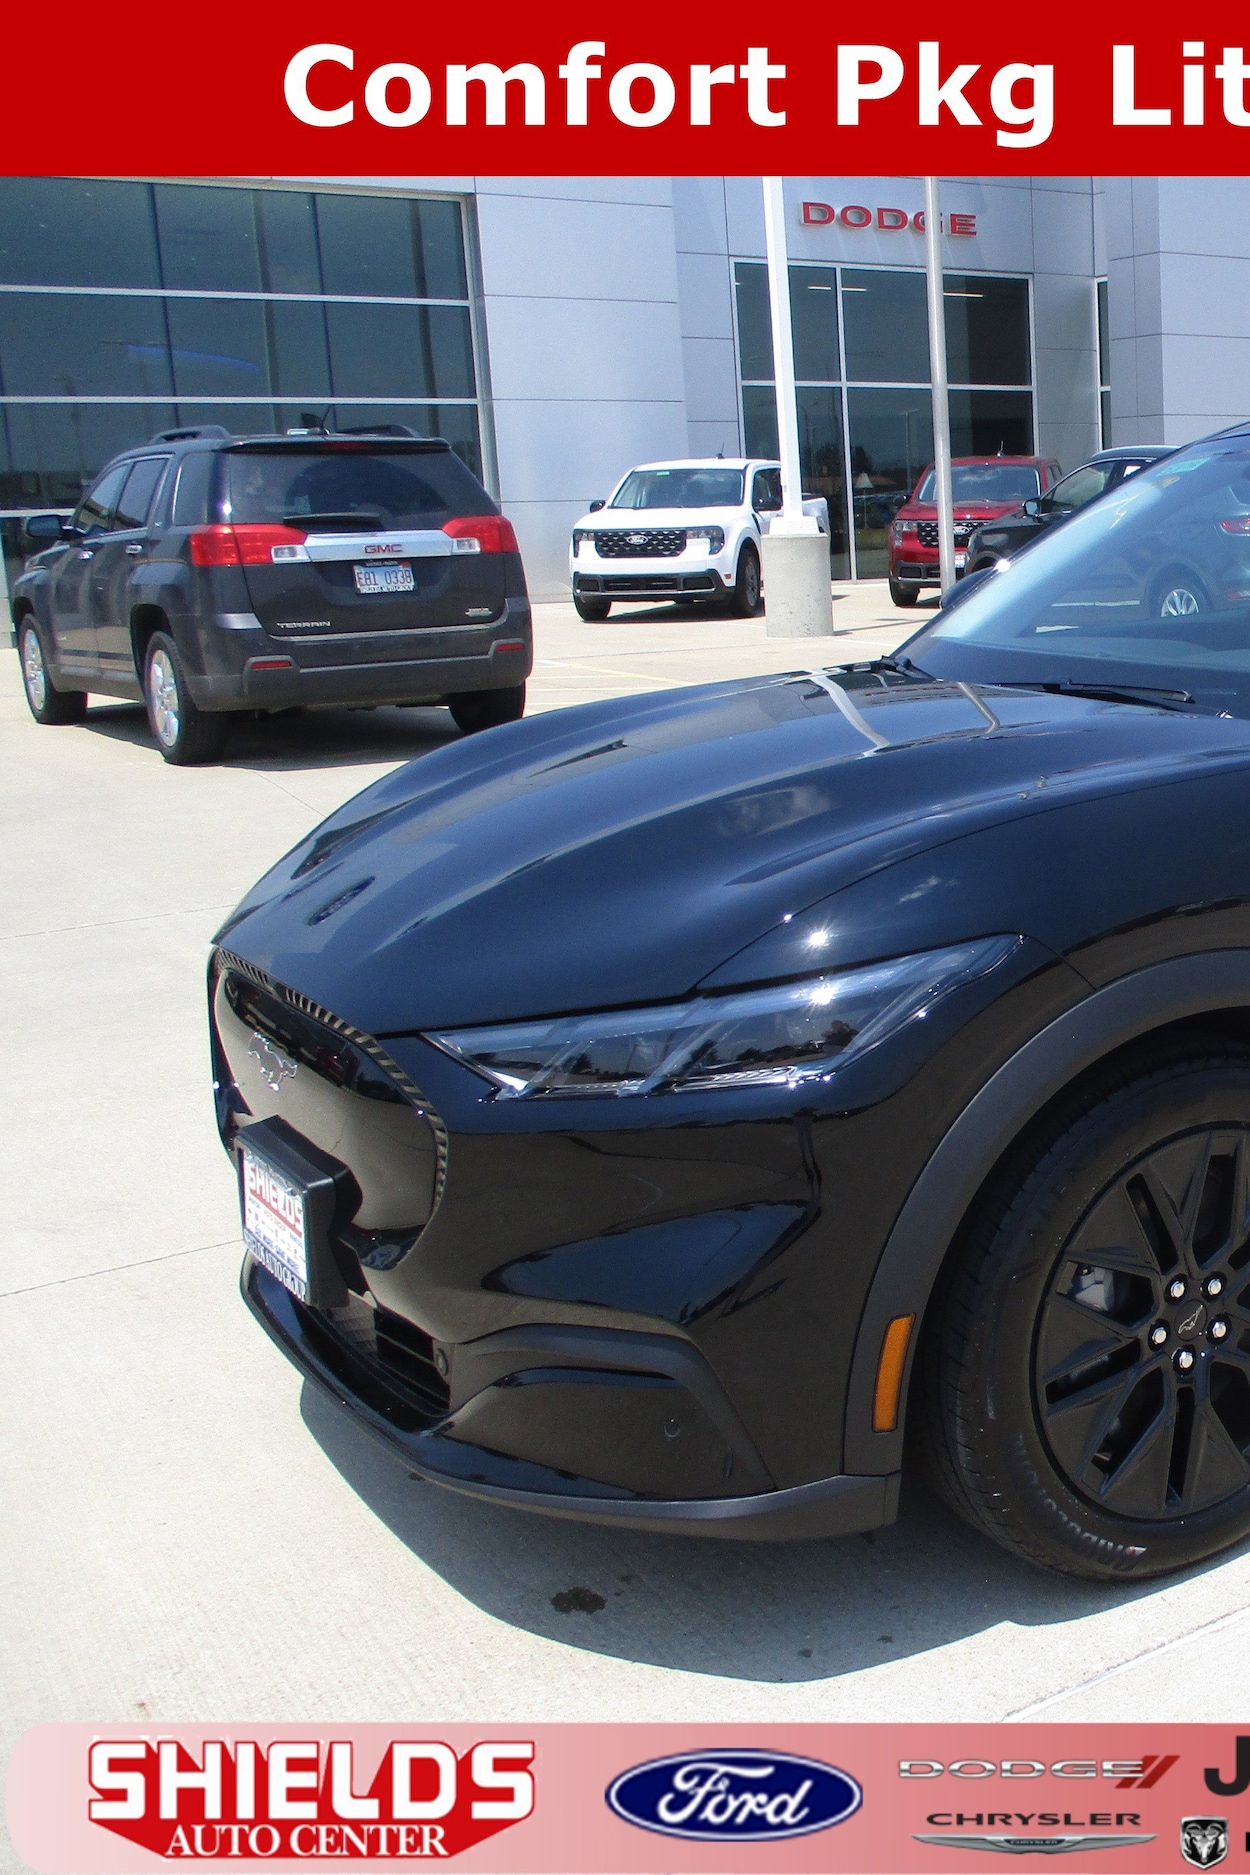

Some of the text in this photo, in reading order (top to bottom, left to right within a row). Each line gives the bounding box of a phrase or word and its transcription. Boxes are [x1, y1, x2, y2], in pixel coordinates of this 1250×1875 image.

[364, 544, 402, 553] GMC
[276, 621, 331, 629] TERRAIN
[247, 1163, 303, 1231] SHIELDS
